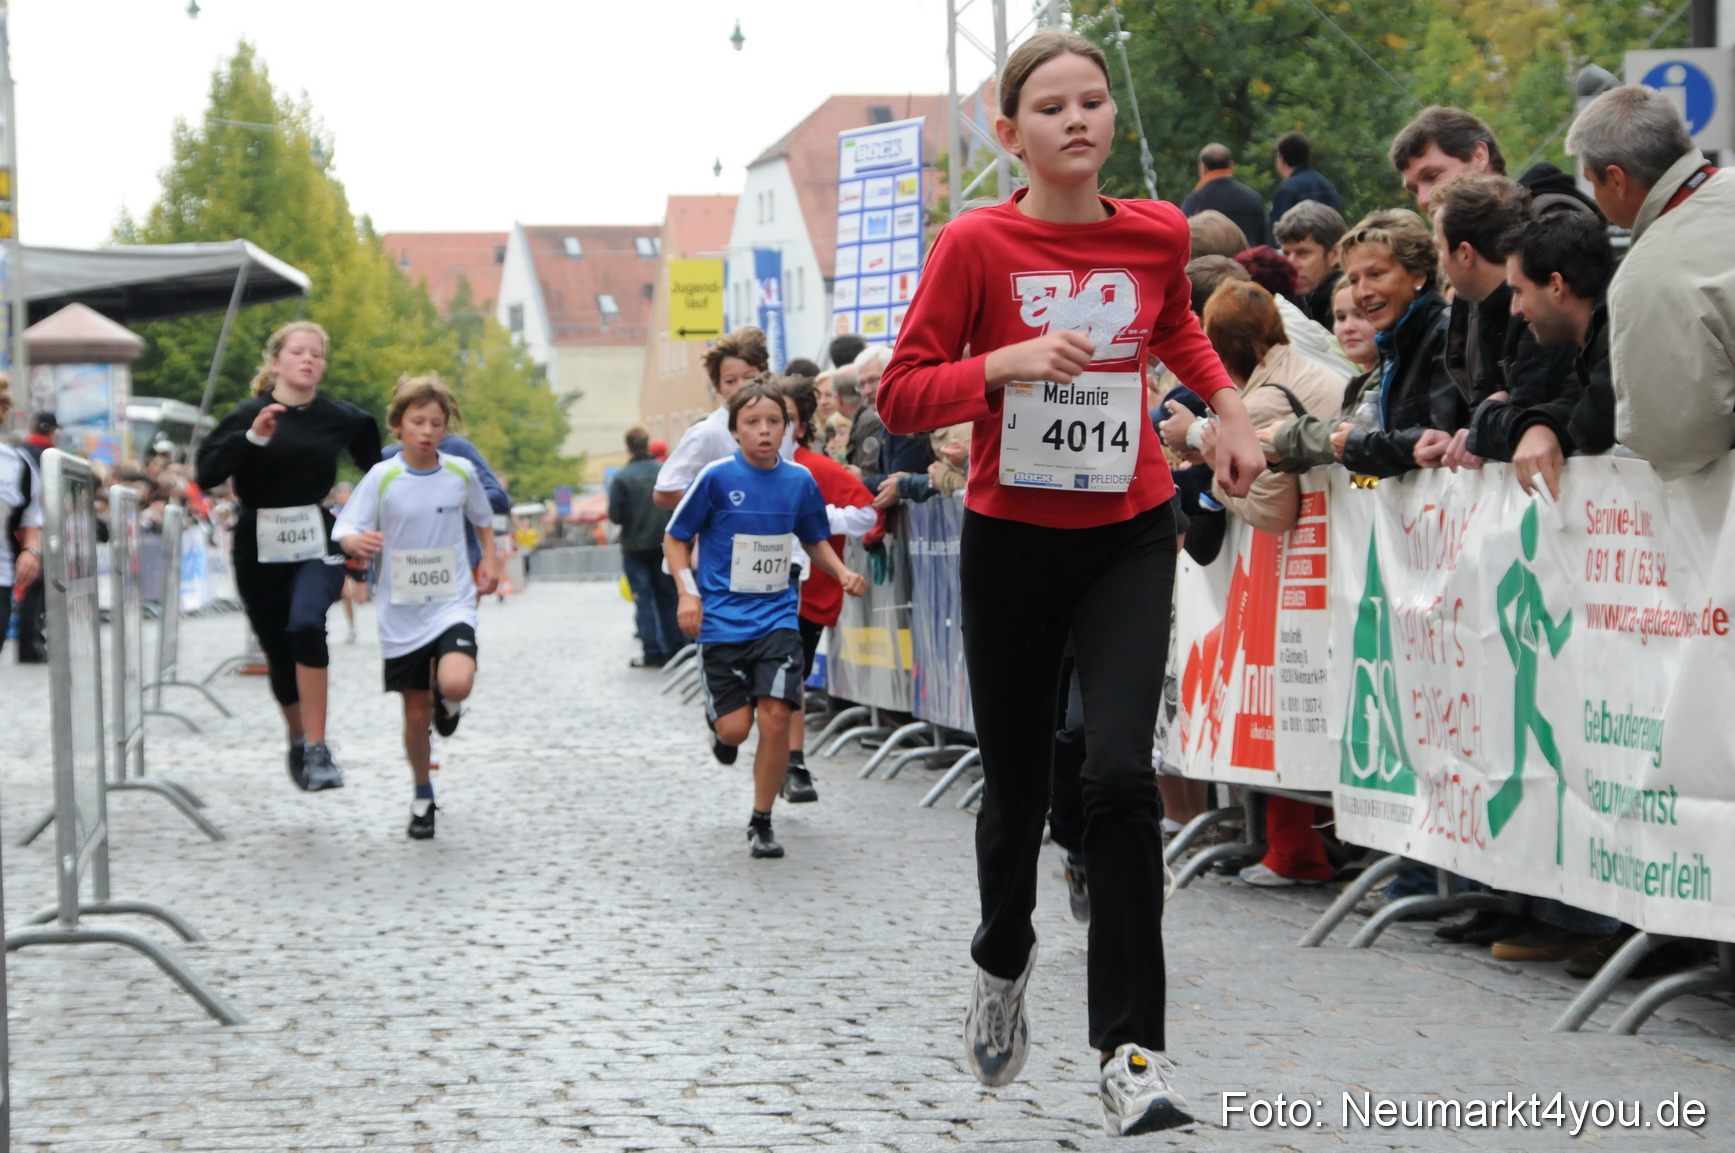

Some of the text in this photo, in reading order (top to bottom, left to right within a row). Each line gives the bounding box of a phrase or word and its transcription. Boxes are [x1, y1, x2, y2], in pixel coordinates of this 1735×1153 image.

[1043, 382, 1109, 406] Melanie
[1008, 413, 1017, 430] J
[1042, 419, 1129, 453] 4014
[277, 527, 315, 544] 4041
[753, 541, 784, 552] Thomas
[406, 554, 441, 565] Nikolaus
[752, 558, 788, 573] 4071
[409, 569, 450, 586] 4060
